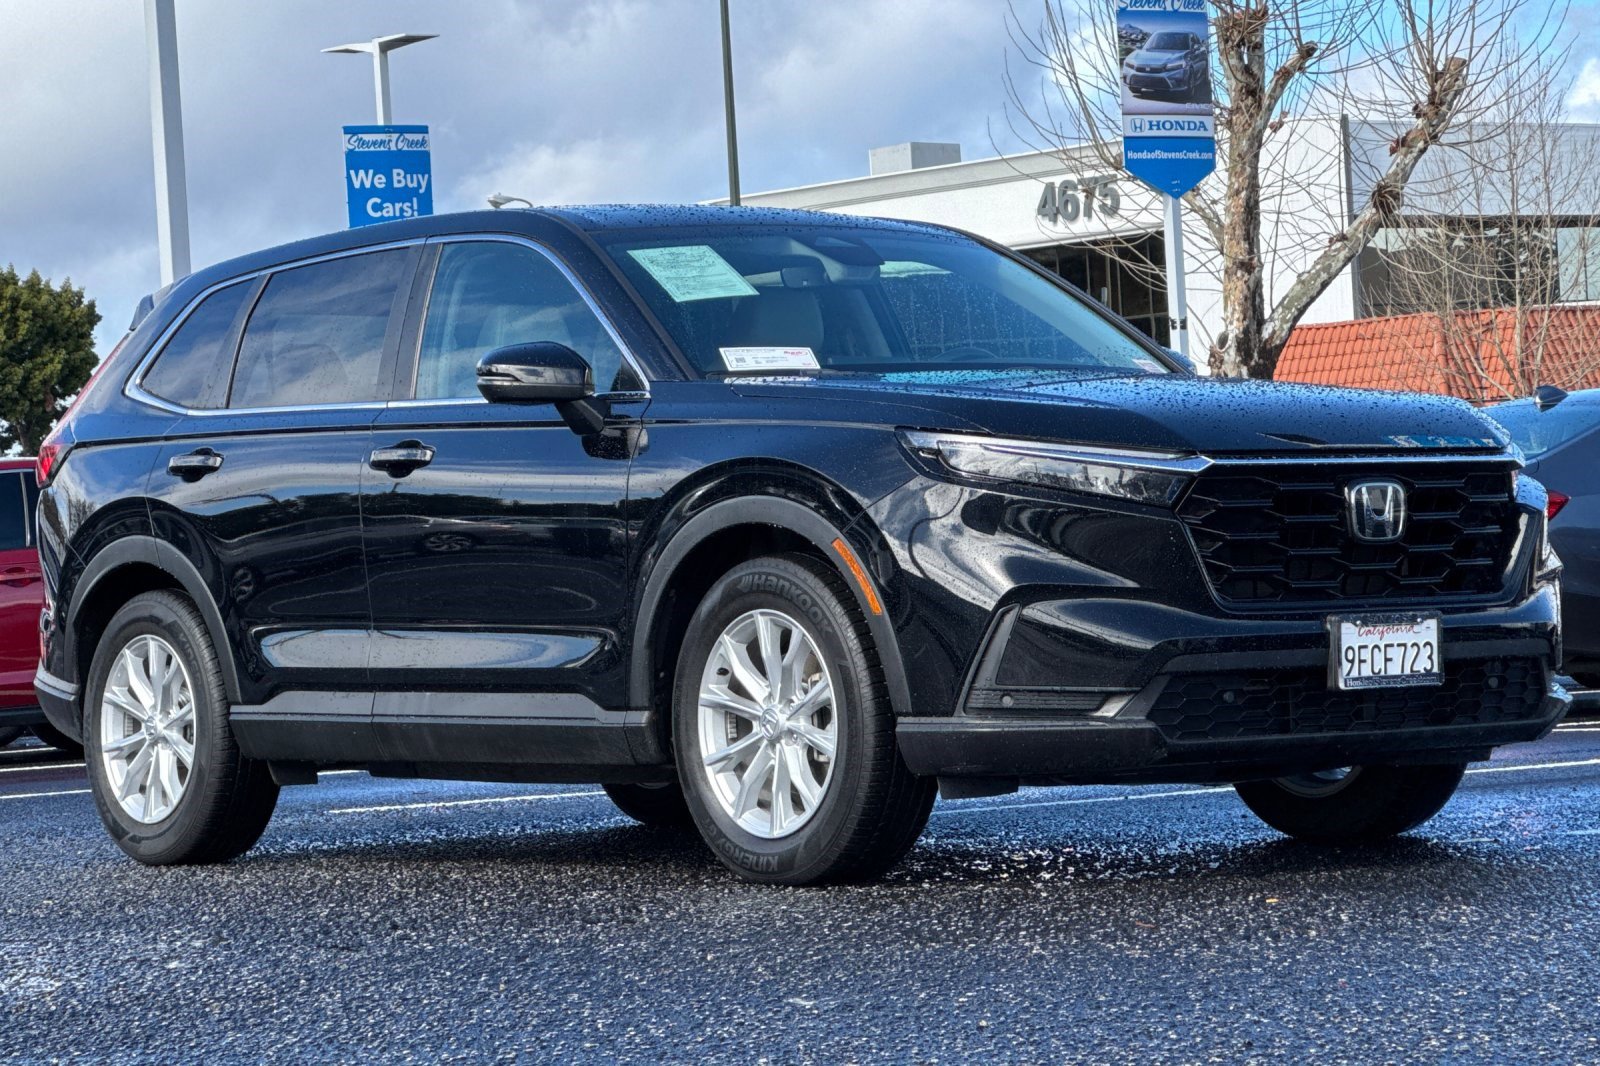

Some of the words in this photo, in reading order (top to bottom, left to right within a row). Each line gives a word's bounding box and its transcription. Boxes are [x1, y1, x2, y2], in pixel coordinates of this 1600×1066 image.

[1147, 120, 1208, 132] HONDA
[347, 133, 393, 151] Stevens
[395, 133, 428, 151] Creek
[1127, 149, 1213, 160] HondaofStevensCreek.com
[349, 168, 387, 189] We
[392, 168, 429, 194] Buy
[366, 197, 419, 218] Cars!
[1037, 174, 1120, 224] 4675
[1357, 623, 1420, 640] California
[1344, 641, 1435, 677] 9FCF723
